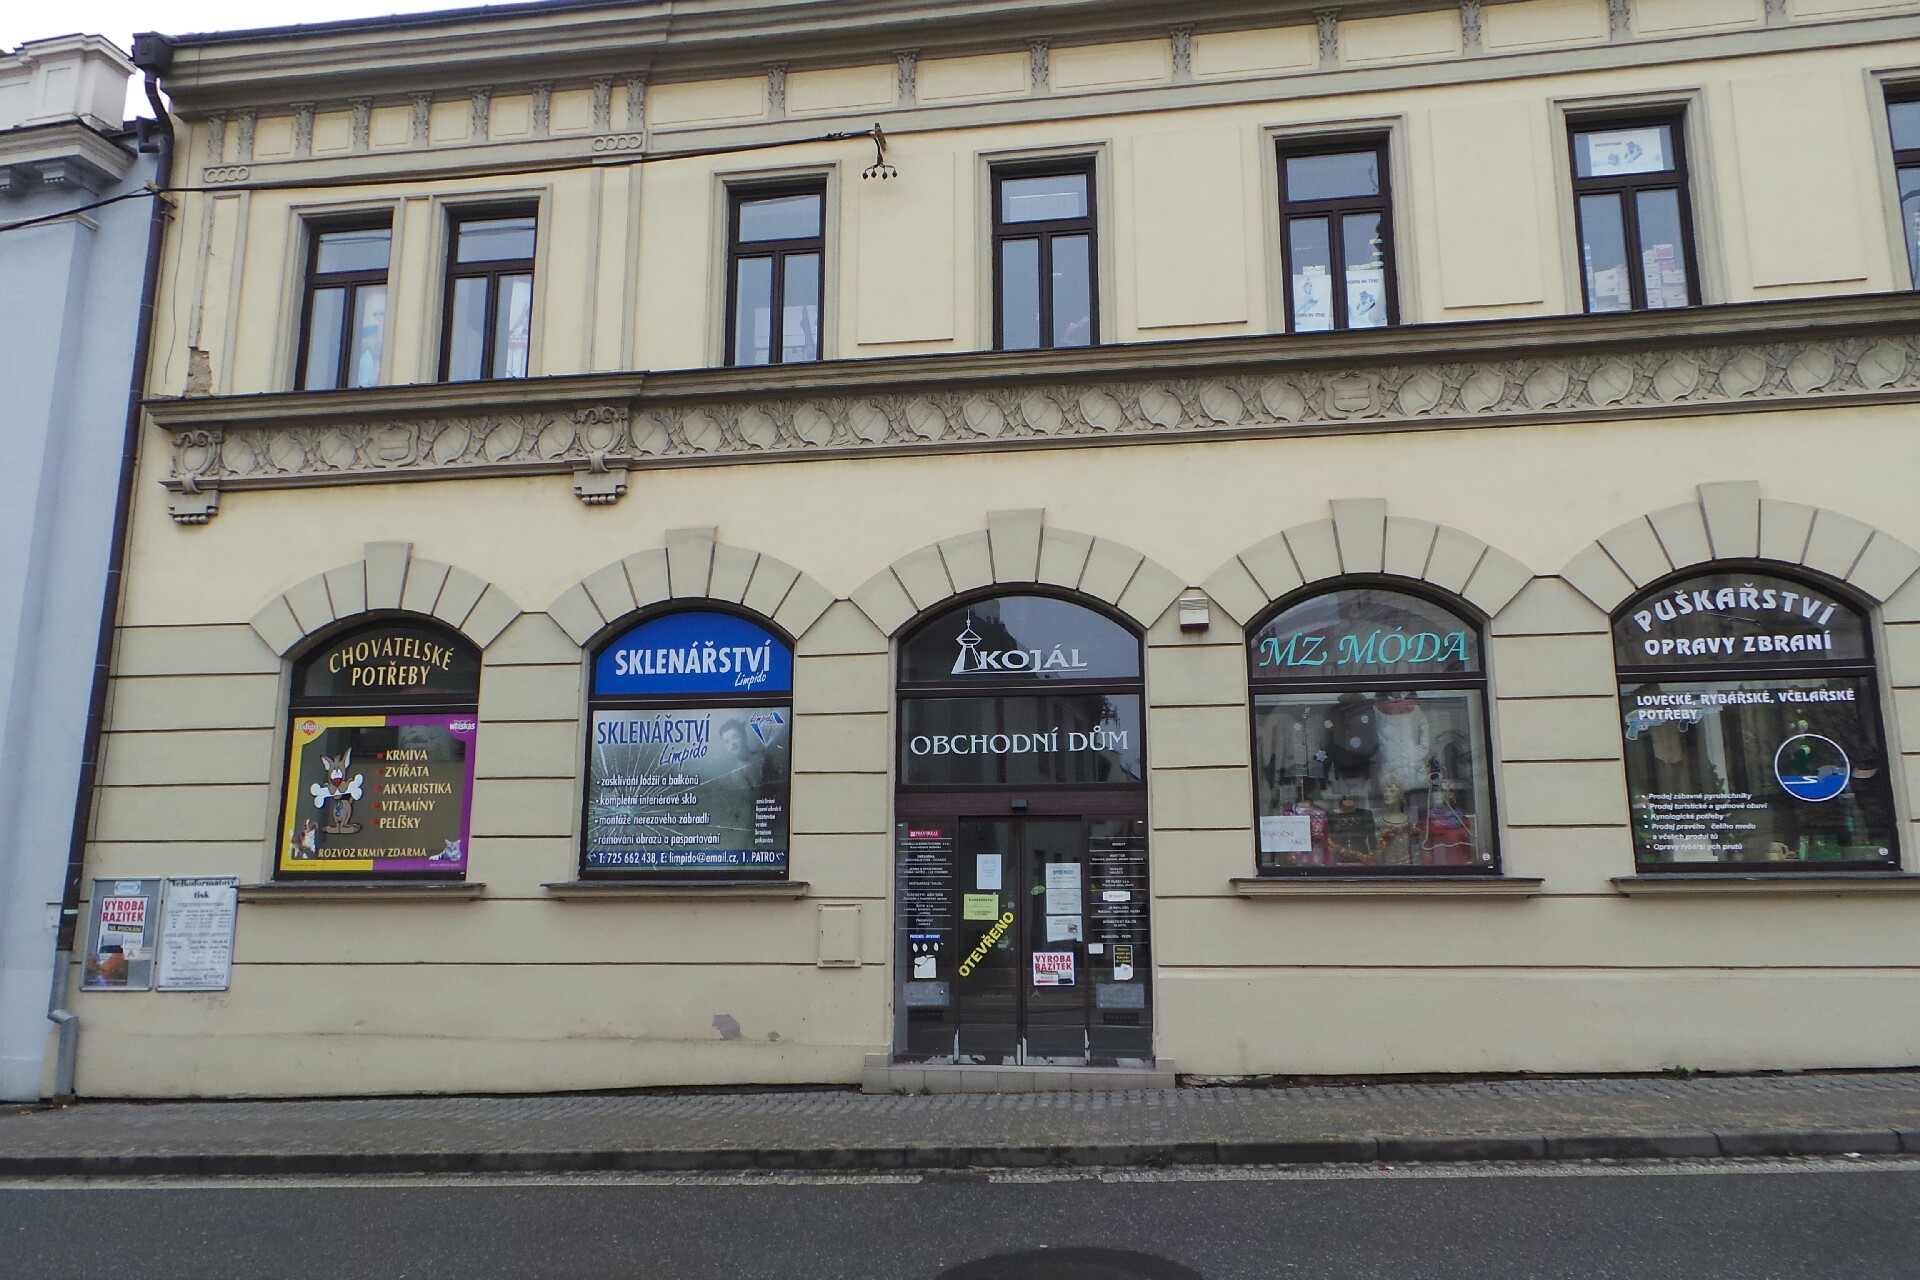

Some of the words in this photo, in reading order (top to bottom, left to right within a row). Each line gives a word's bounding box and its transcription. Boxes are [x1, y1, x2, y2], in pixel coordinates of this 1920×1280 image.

[1632, 582, 1839, 634] PUŠKAŘSTVÍ
[1259, 632, 1328, 666] MZ
[1337, 626, 1470, 664] MÓDA
[1643, 636, 1736, 656] OPRAVY
[1742, 630, 1832, 653] ZBRANÍ
[329, 637, 454, 674] CHOVATELSKÉ
[614, 639, 771, 676] SKLENÁŘSTVÍ
[980, 643, 1088, 673] KOJÁL
[351, 661, 430, 686] POTŘEBY
[735, 670, 766, 690] Limpido
[1636, 691, 1696, 706] LOVECKÉ,
[1700, 690, 1774, 705] RYBÁŘSKÉ,
[1777, 688, 1855, 702] VČELAŘSKÉ
[1638, 706, 1698, 721] POTŘEBY
[449, 722, 476, 731] whiskas
[597, 714, 711, 745] SKLENÁŘSTVÍ
[910, 726, 1059, 756] OBCHODNÍ
[1068, 725, 1129, 753] DŮM
[386, 750, 428, 761] KRMIVA
[659, 739, 708, 771] Limpido
[384, 763, 430, 778] ZVÍŘATA
[601, 774, 638, 786] zasklívání
[661, 777, 667, 785] a
[669, 774, 699, 786] balkónů
[382, 783, 452, 794] AKVARISTIKA
[600, 793, 638, 807] kompletní
[639, 794, 680, 805] interiérové
[681, 793, 697, 804] sklo
[1648, 793, 1672, 801] Prodej
[1704, 793, 1752, 801] pyrotechniky
[381, 799, 435, 812] VITAMÍNY
[379, 815, 421, 829] PELÍŠKY
[599, 813, 631, 825] montáže
[633, 813, 677, 825] nerezového
[679, 812, 710, 825] zábradlí
[1650, 813, 1695, 821] Kynologické
[1695, 813, 1724, 821] potřeby
[1651, 823, 1676, 831] Prodej
[598, 834, 634, 845] rámování
[636, 832, 661, 844] obrazů
[663, 836, 669, 844] a
[671, 833, 721, 846] paspartování
[318, 848, 356, 858] ROZVOZ
[357, 847, 386, 858] KRMIV
[387, 847, 427, 857] ZDARMA
[1653, 843, 1682, 851] Opravy
[1722, 843, 1743, 851] prutů
[600, 852, 606, 863] T:
[607, 852, 622, 863] 725
[624, 852, 639, 863] 662
[641, 852, 658, 866] 438,
[742, 852, 749, 862] 1.
[751, 852, 775, 863] PATRO
[194, 890, 210, 899] tisk
[104, 898, 145, 911] VÝROBA
[102, 911, 144, 922] RAZÍTEK
[958, 911, 1015, 978] OTEVŘENO
[1035, 954, 1072, 963] VÝROBA
[1035, 963, 1072, 971] RAZÍTEK
